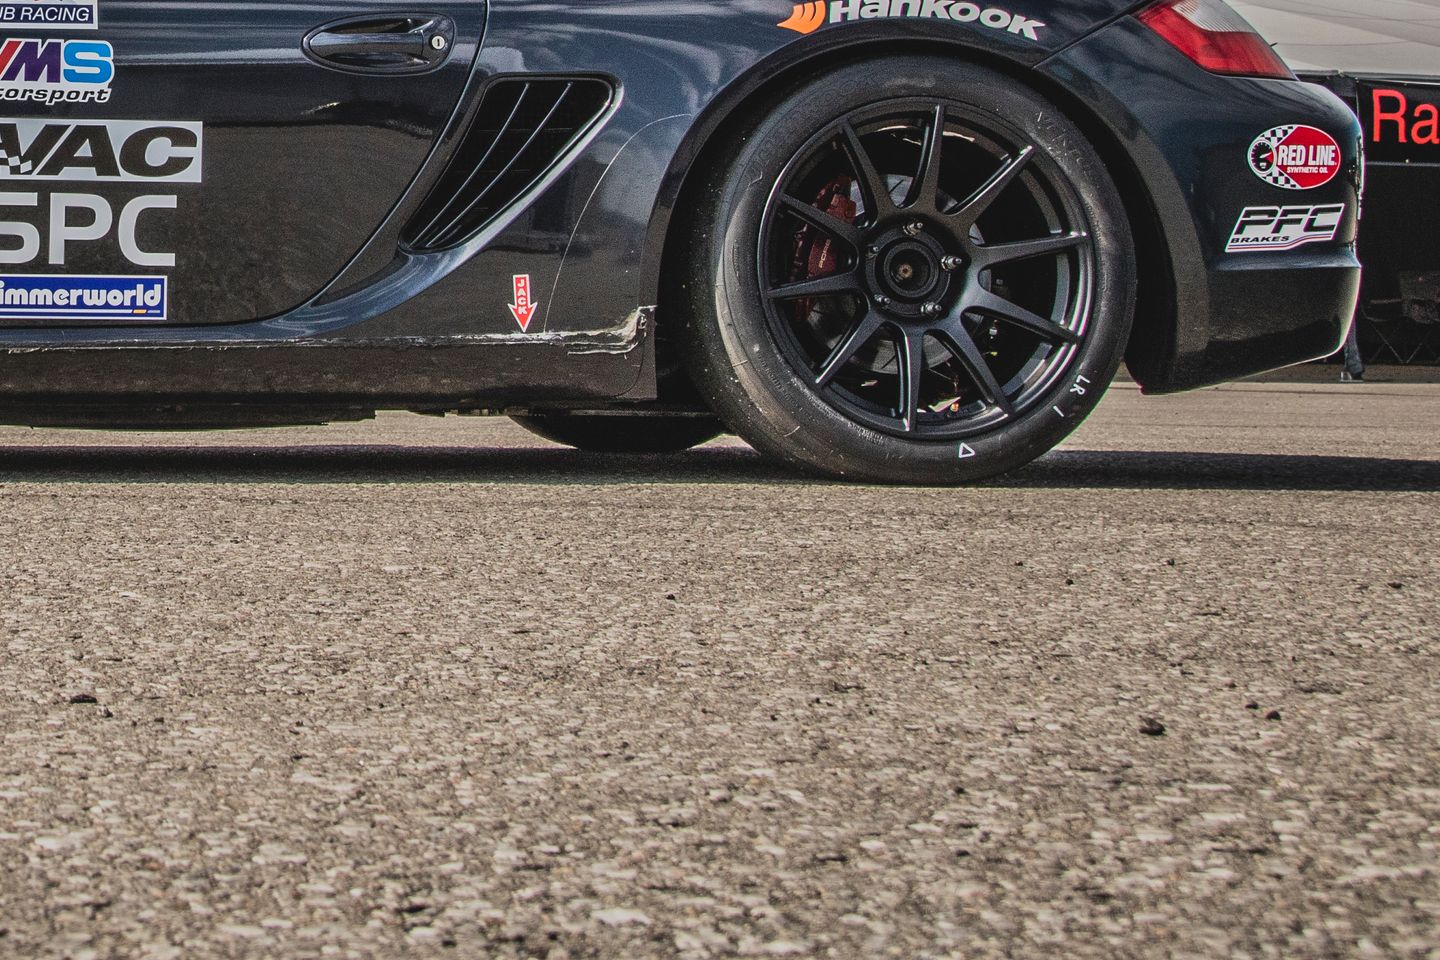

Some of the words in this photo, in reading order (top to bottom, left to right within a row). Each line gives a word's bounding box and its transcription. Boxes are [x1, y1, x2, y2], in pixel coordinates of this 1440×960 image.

[20, 7, 90, 22] RACING
[1277, 144, 1306, 166] RED
[1308, 144, 1336, 166] LINE
[1286, 166, 1319, 174] SYNTHETIC
[1318, 166, 1329, 174] OIL
[1234, 206, 1342, 235] PFC
[1230, 235, 1290, 244] BRAKES
[517, 278, 528, 315] JACK
